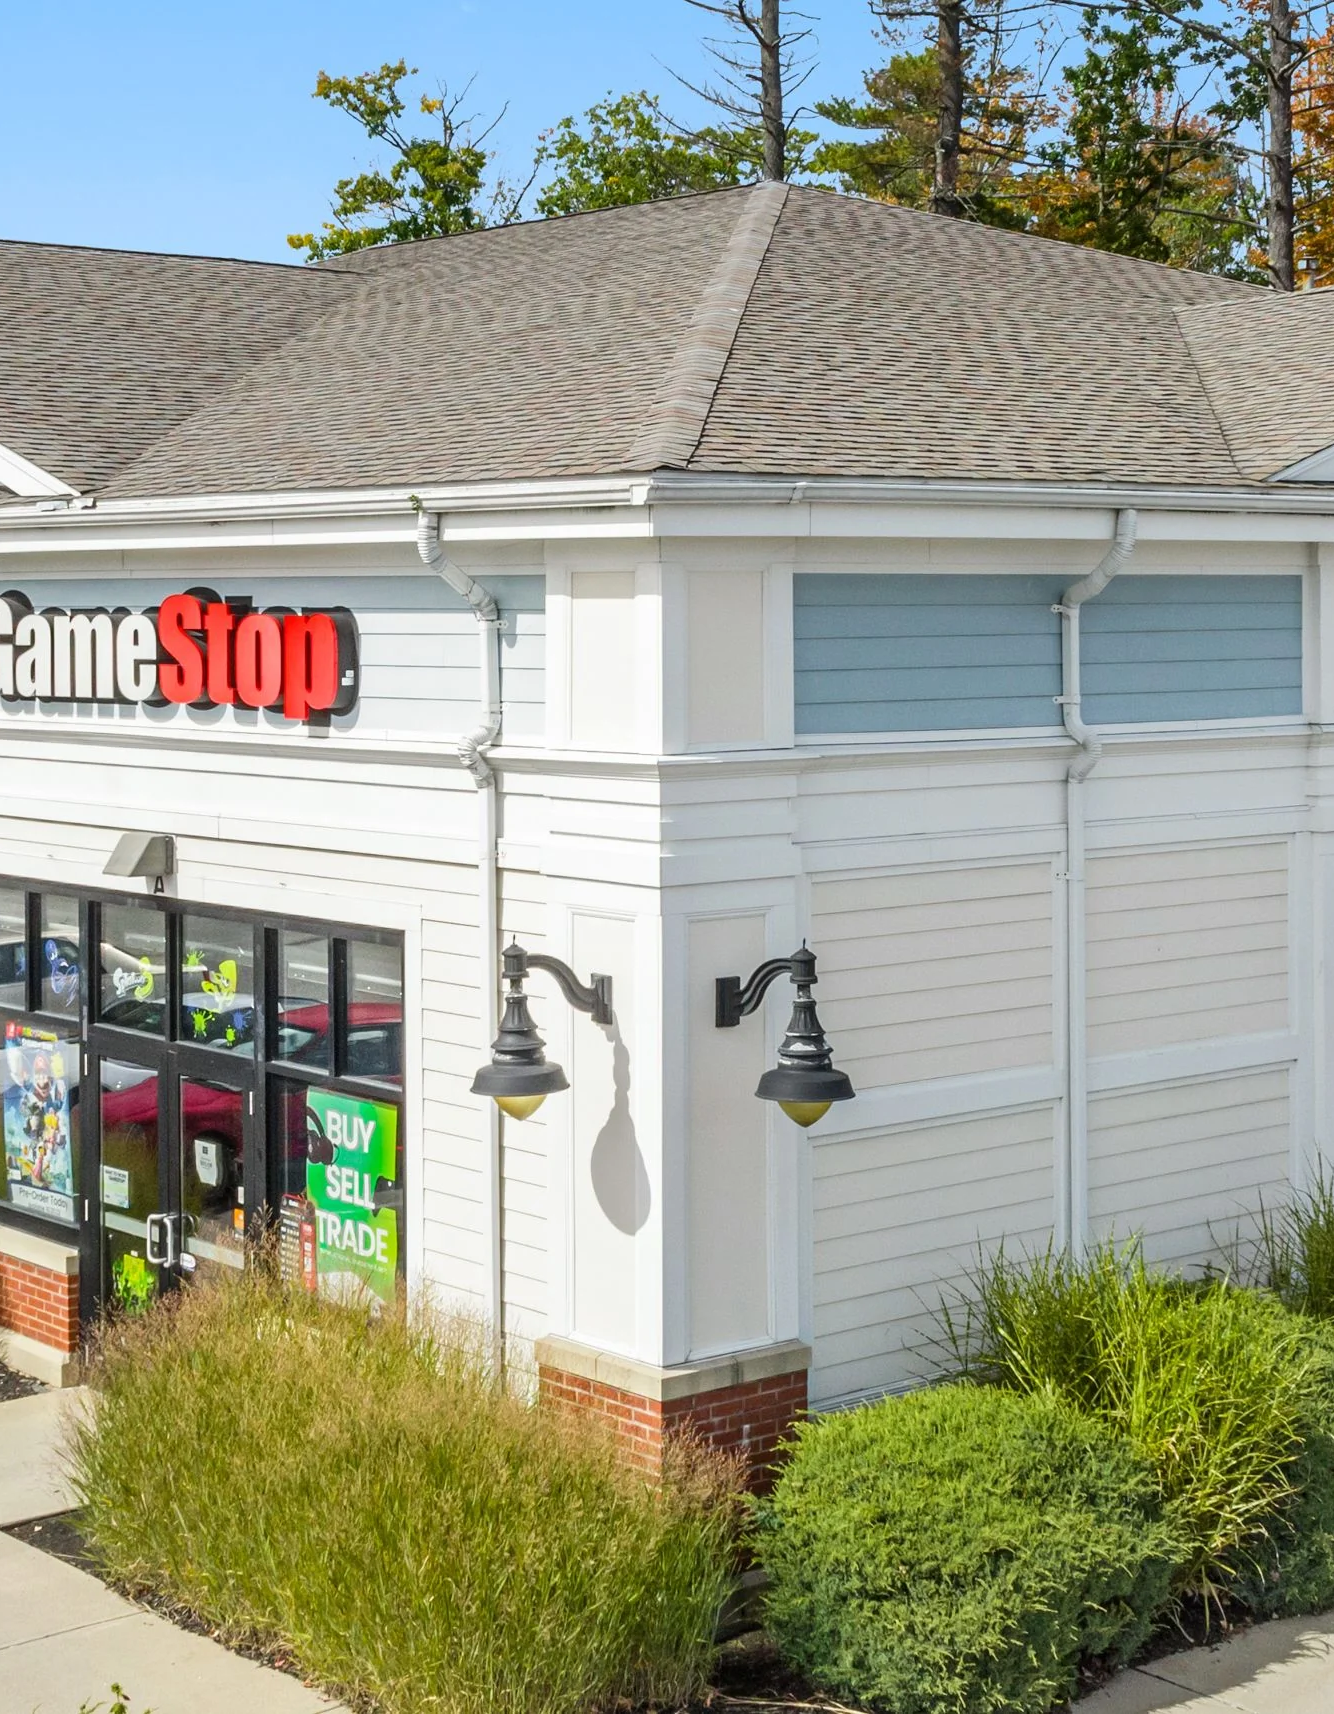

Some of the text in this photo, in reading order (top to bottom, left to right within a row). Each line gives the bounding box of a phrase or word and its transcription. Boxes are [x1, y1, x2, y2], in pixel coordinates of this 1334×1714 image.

[153, 876, 165, 894] A
[326, 1110, 376, 1154] BUY
[19, 1187, 50, 1205] Pre-Order
[325, 1164, 376, 1210] SELL
[315, 1209, 389, 1264] TRADE
